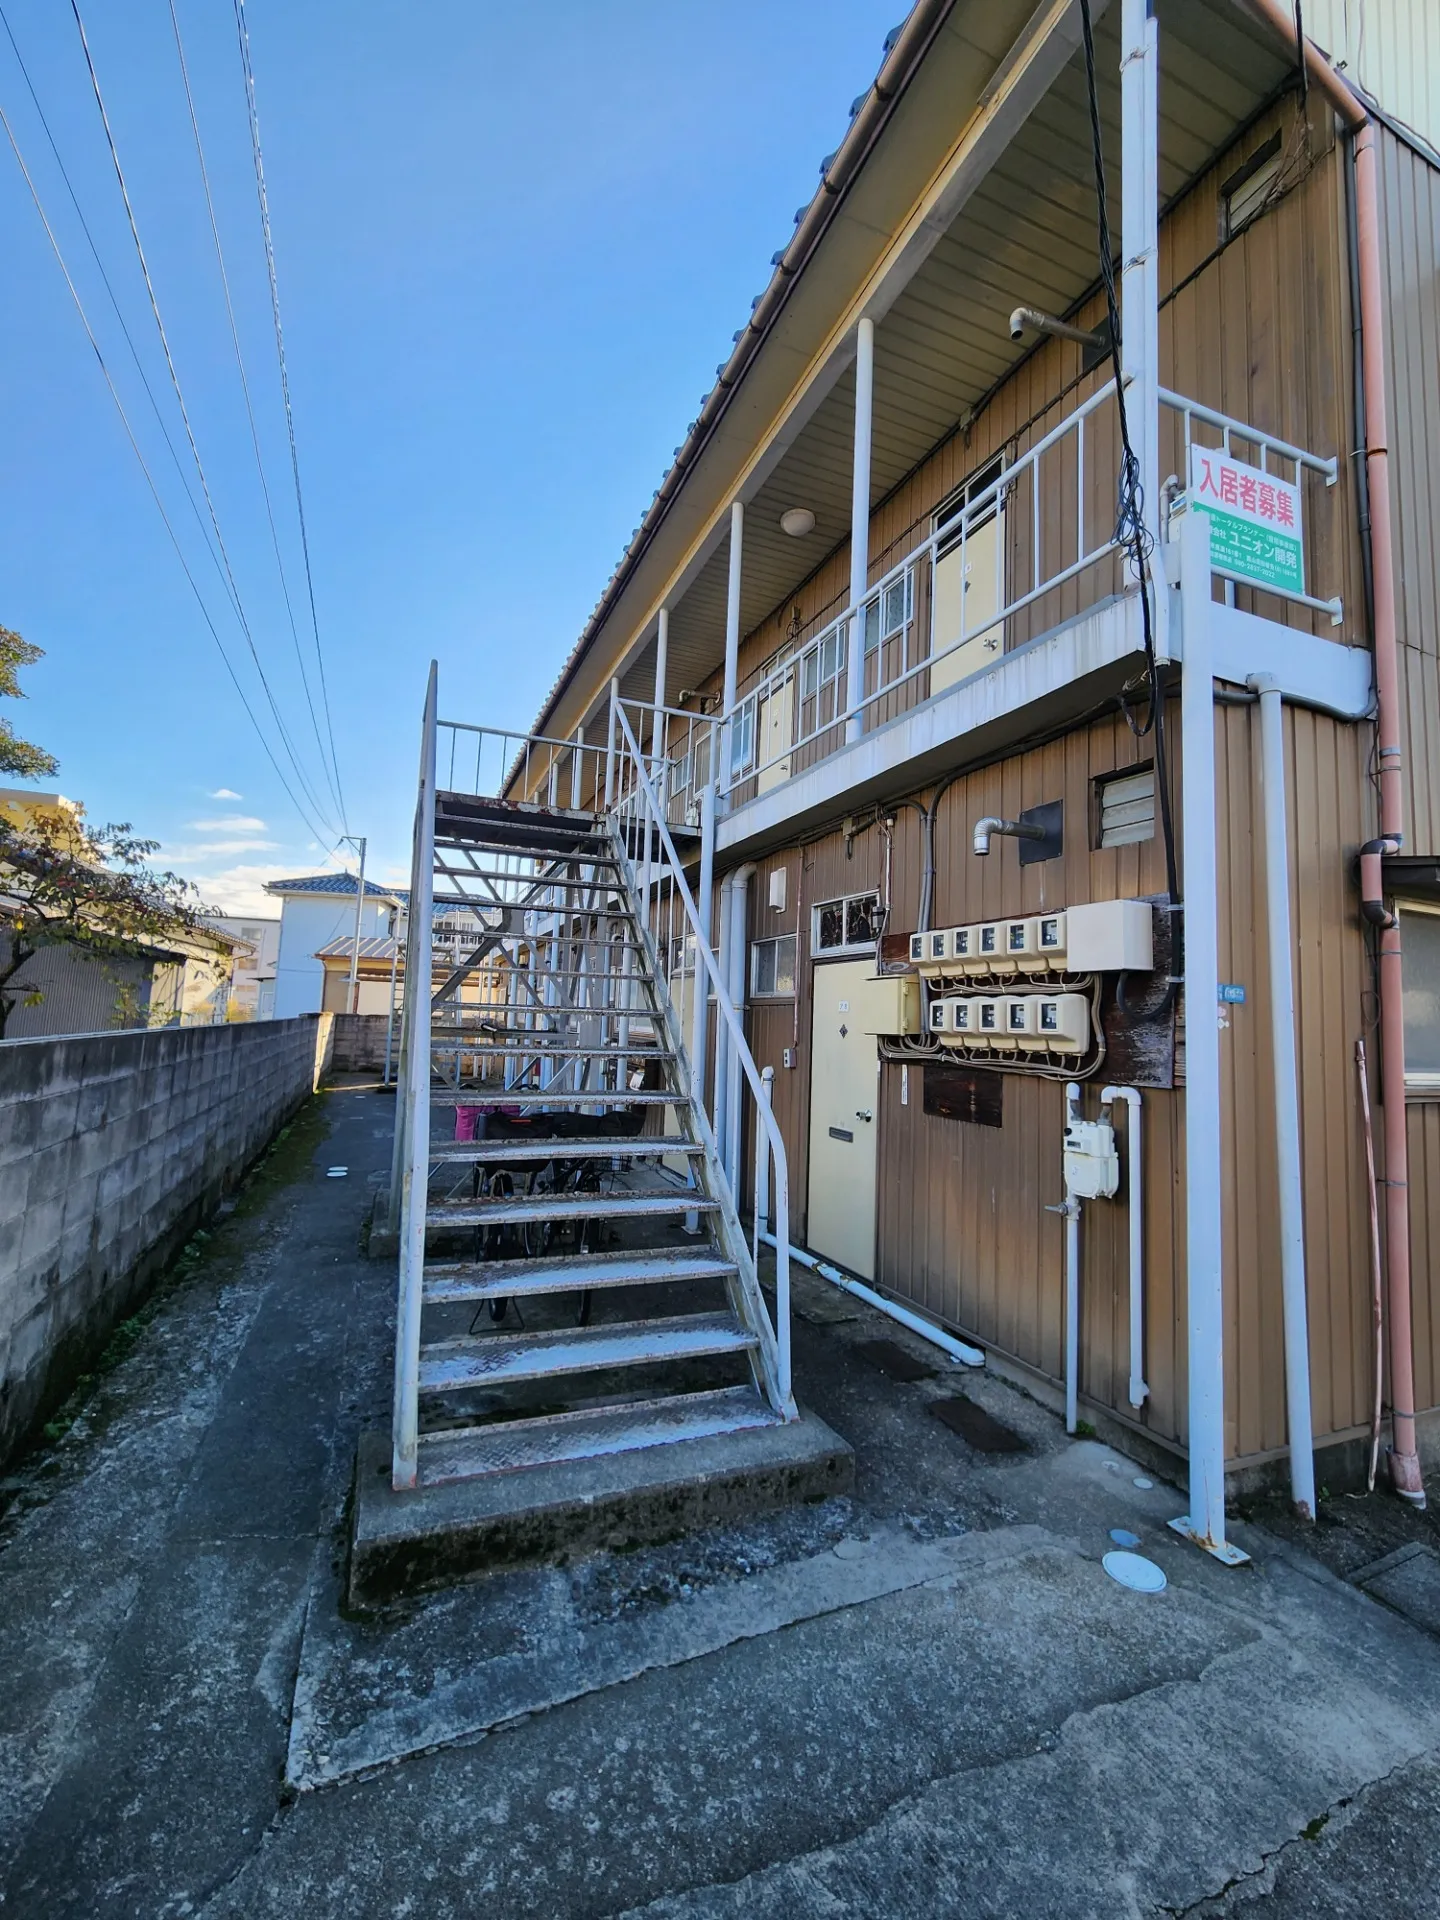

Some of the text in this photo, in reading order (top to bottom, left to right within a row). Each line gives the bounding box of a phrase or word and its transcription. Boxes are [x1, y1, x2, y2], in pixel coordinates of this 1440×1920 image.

[1199, 458, 1295, 528] 入居者募集
[1229, 531, 1297, 569] ユニオン開発
